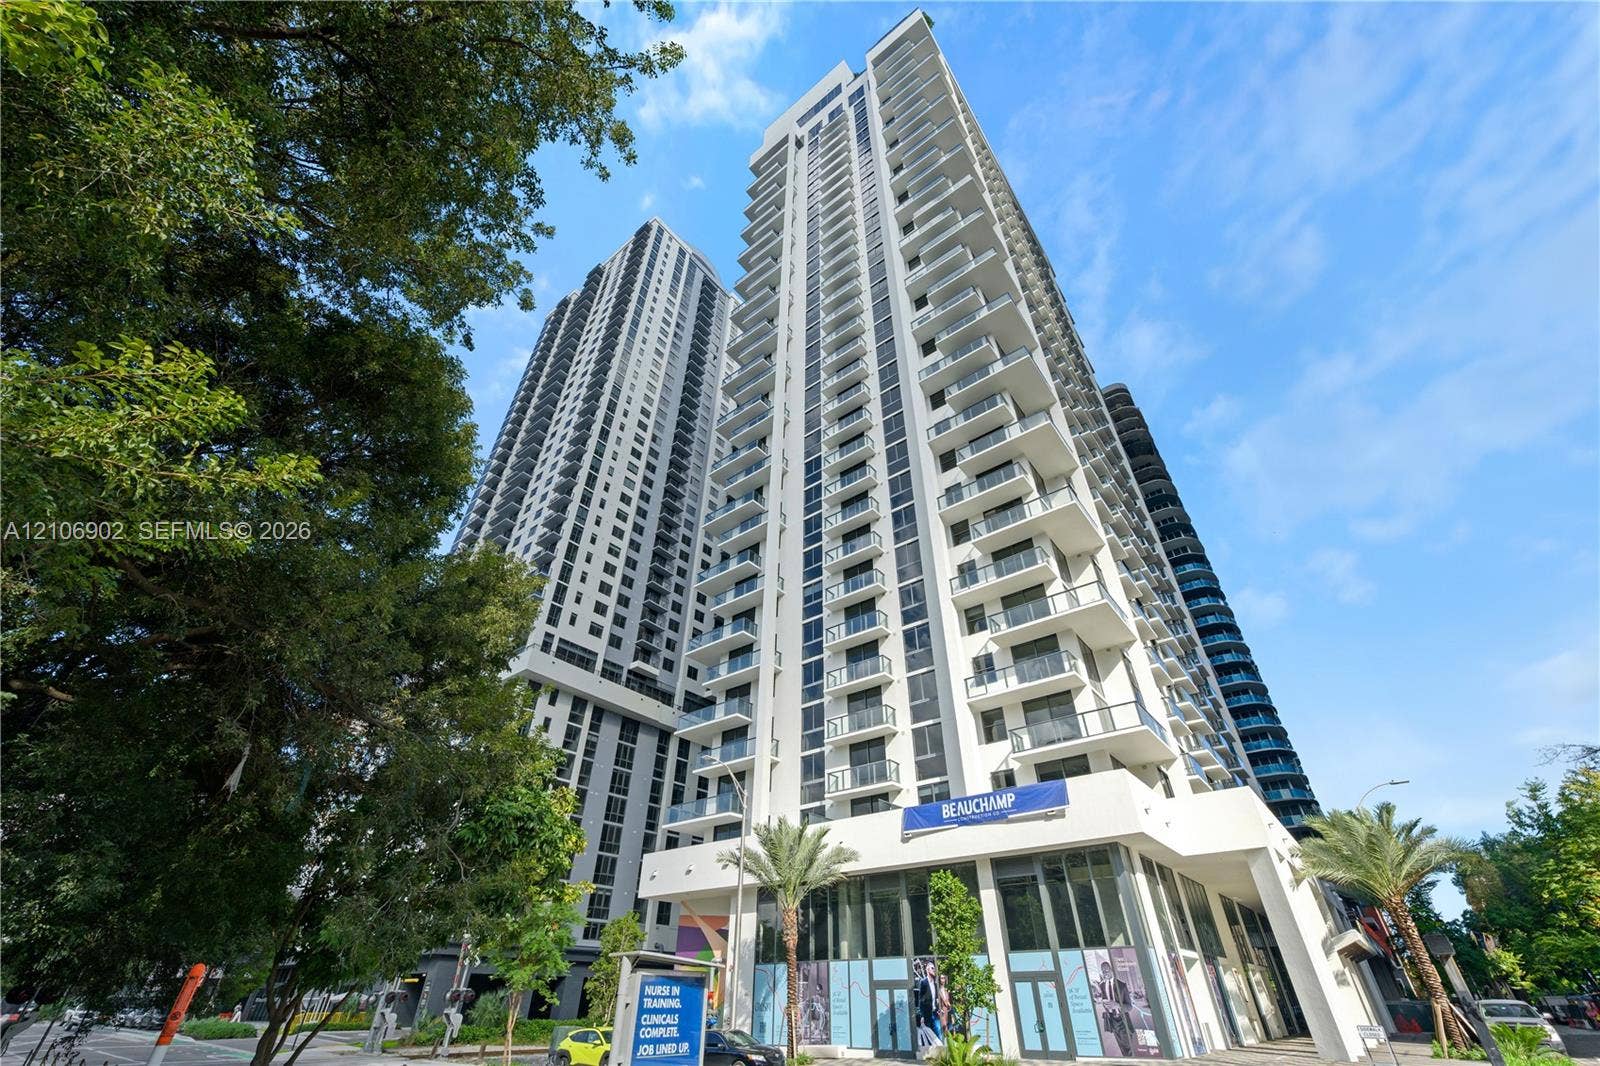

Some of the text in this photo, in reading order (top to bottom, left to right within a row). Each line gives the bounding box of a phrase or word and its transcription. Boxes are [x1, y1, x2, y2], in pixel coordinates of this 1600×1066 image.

[942, 793, 1015, 818] BEAUCHAMP
[644, 985, 680, 996] NURSE IN
[643, 998, 682, 1009] TRAINING.
[641, 1014, 679, 1025] CLINICALS
[640, 1027, 680, 1038] COMPLETE.
[637, 1042, 690, 1056] JOB LINED UP.
